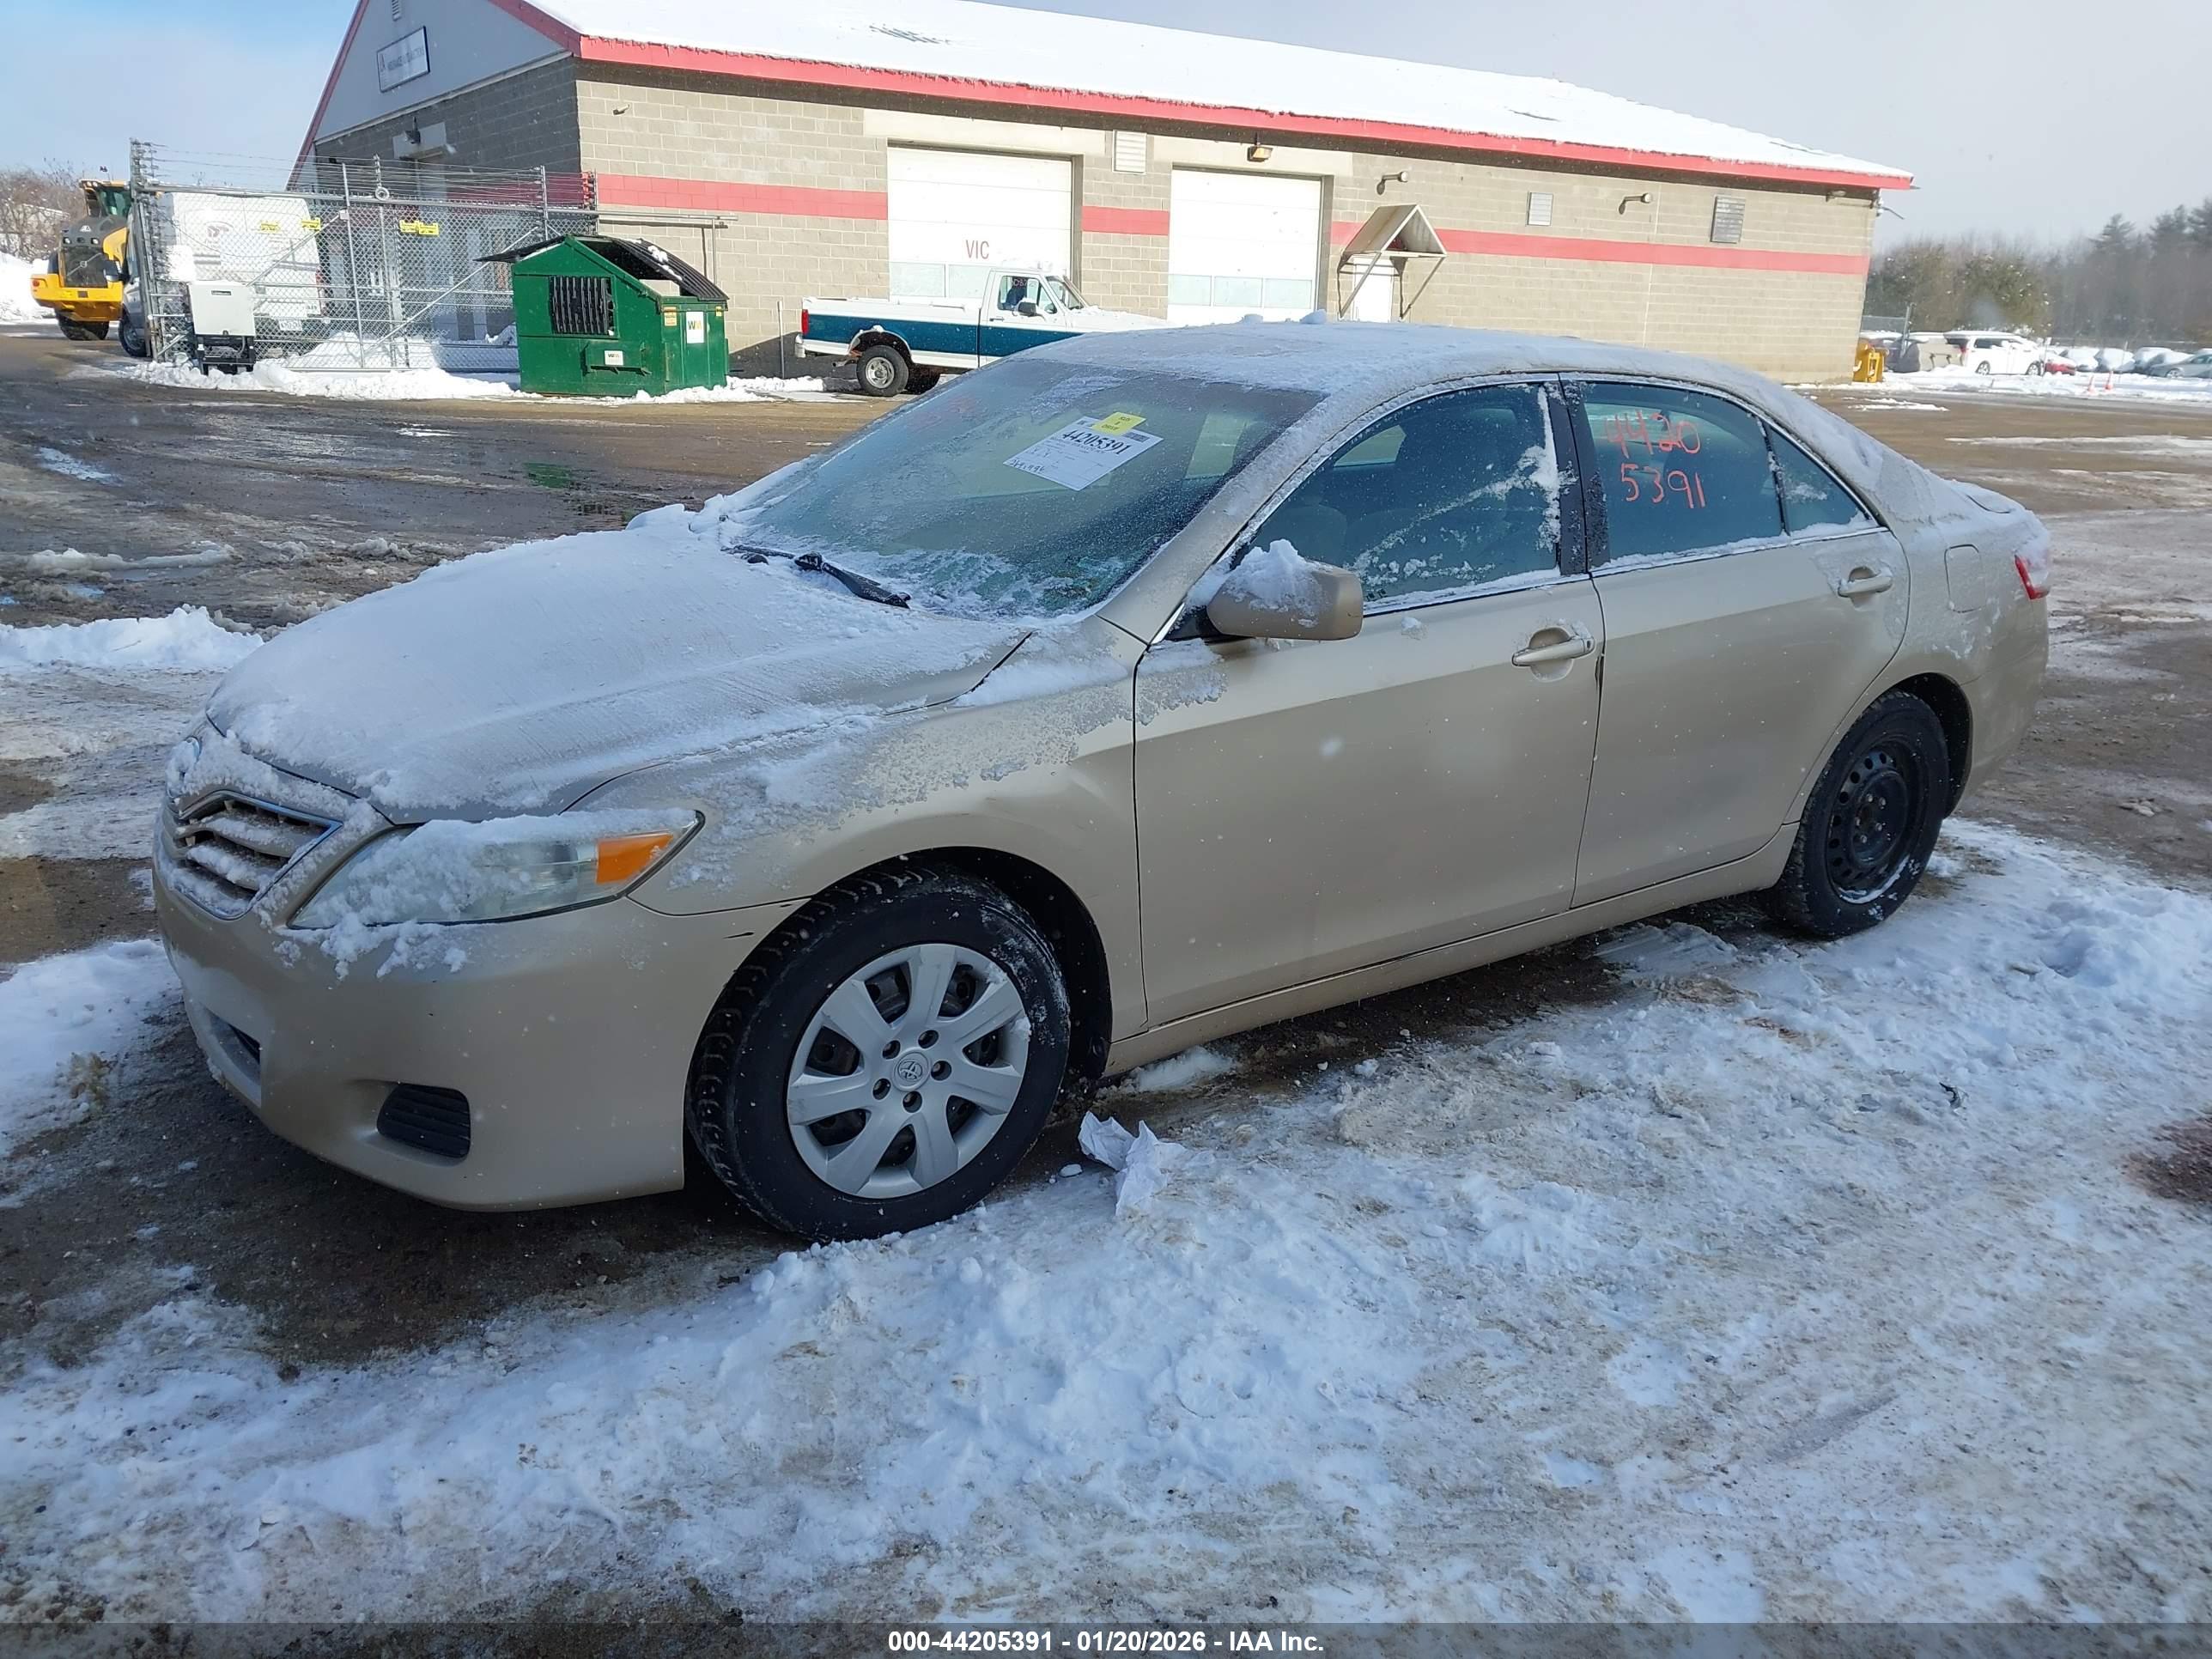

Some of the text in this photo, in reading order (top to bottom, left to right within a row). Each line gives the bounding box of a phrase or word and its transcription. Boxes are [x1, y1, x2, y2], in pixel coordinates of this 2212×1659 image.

[965, 240, 989, 259] VIC
[1062, 429, 1133, 455] 44205391
[1604, 410, 1701, 459] 4420
[1620, 462, 1706, 509] 5391
